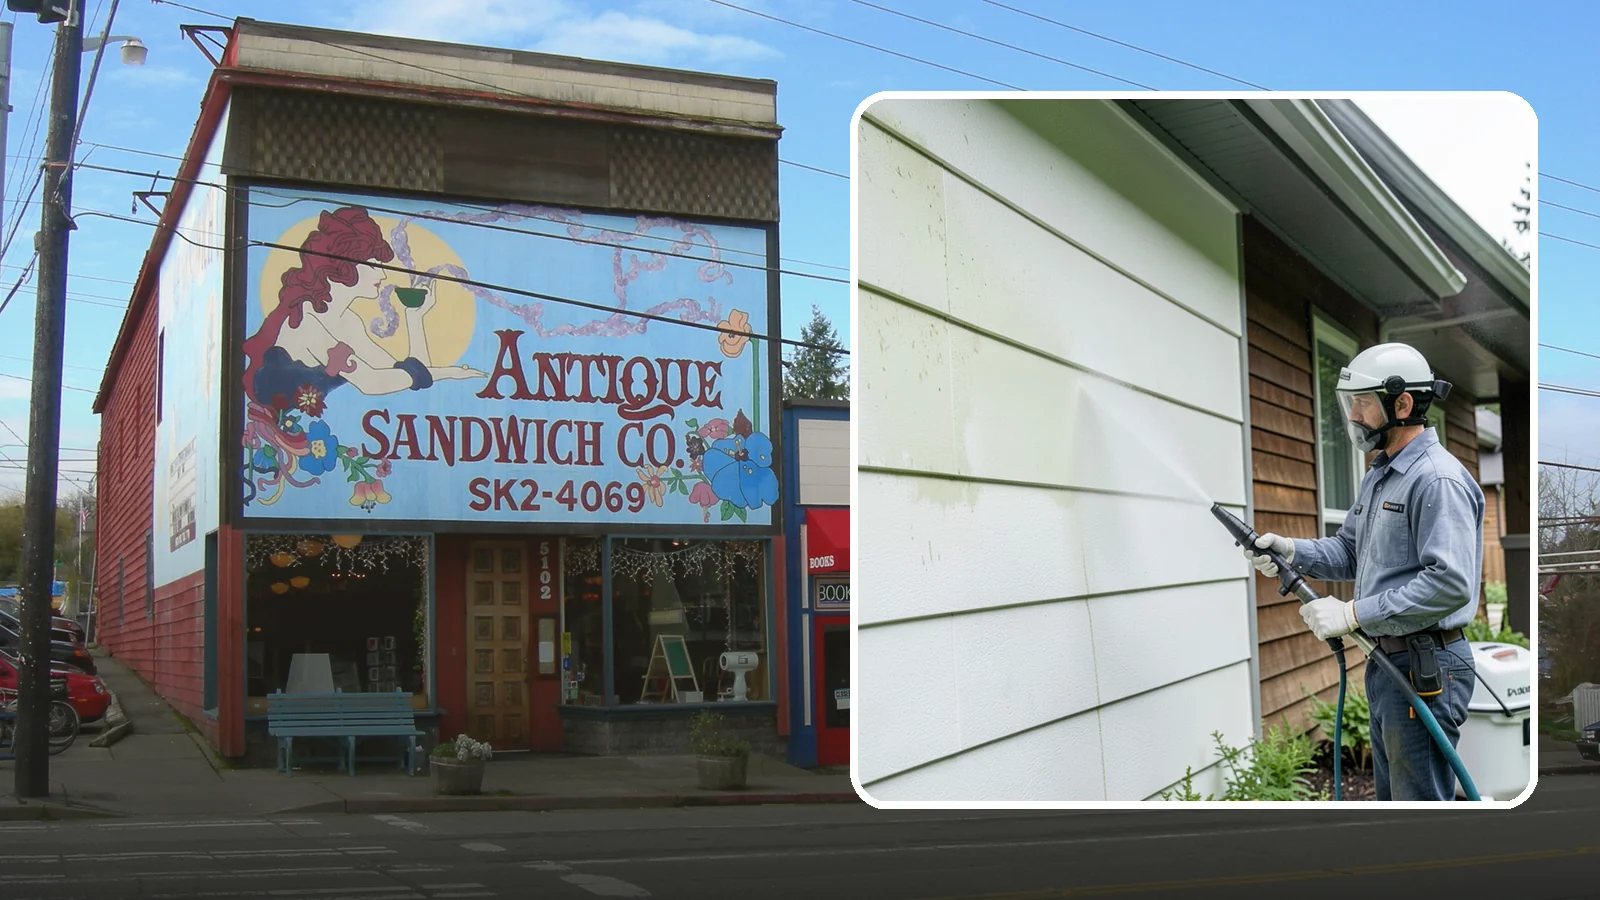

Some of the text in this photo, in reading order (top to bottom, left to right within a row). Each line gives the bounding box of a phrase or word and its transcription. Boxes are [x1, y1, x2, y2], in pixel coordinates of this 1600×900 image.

[476, 329, 724, 420] ANTIQUE
[361, 408, 685, 468] SANDWICH CO.
[468, 477, 646, 513] SK2-4069
[540, 541, 551, 600] 5102
[809, 555, 835, 569] BOOKS
